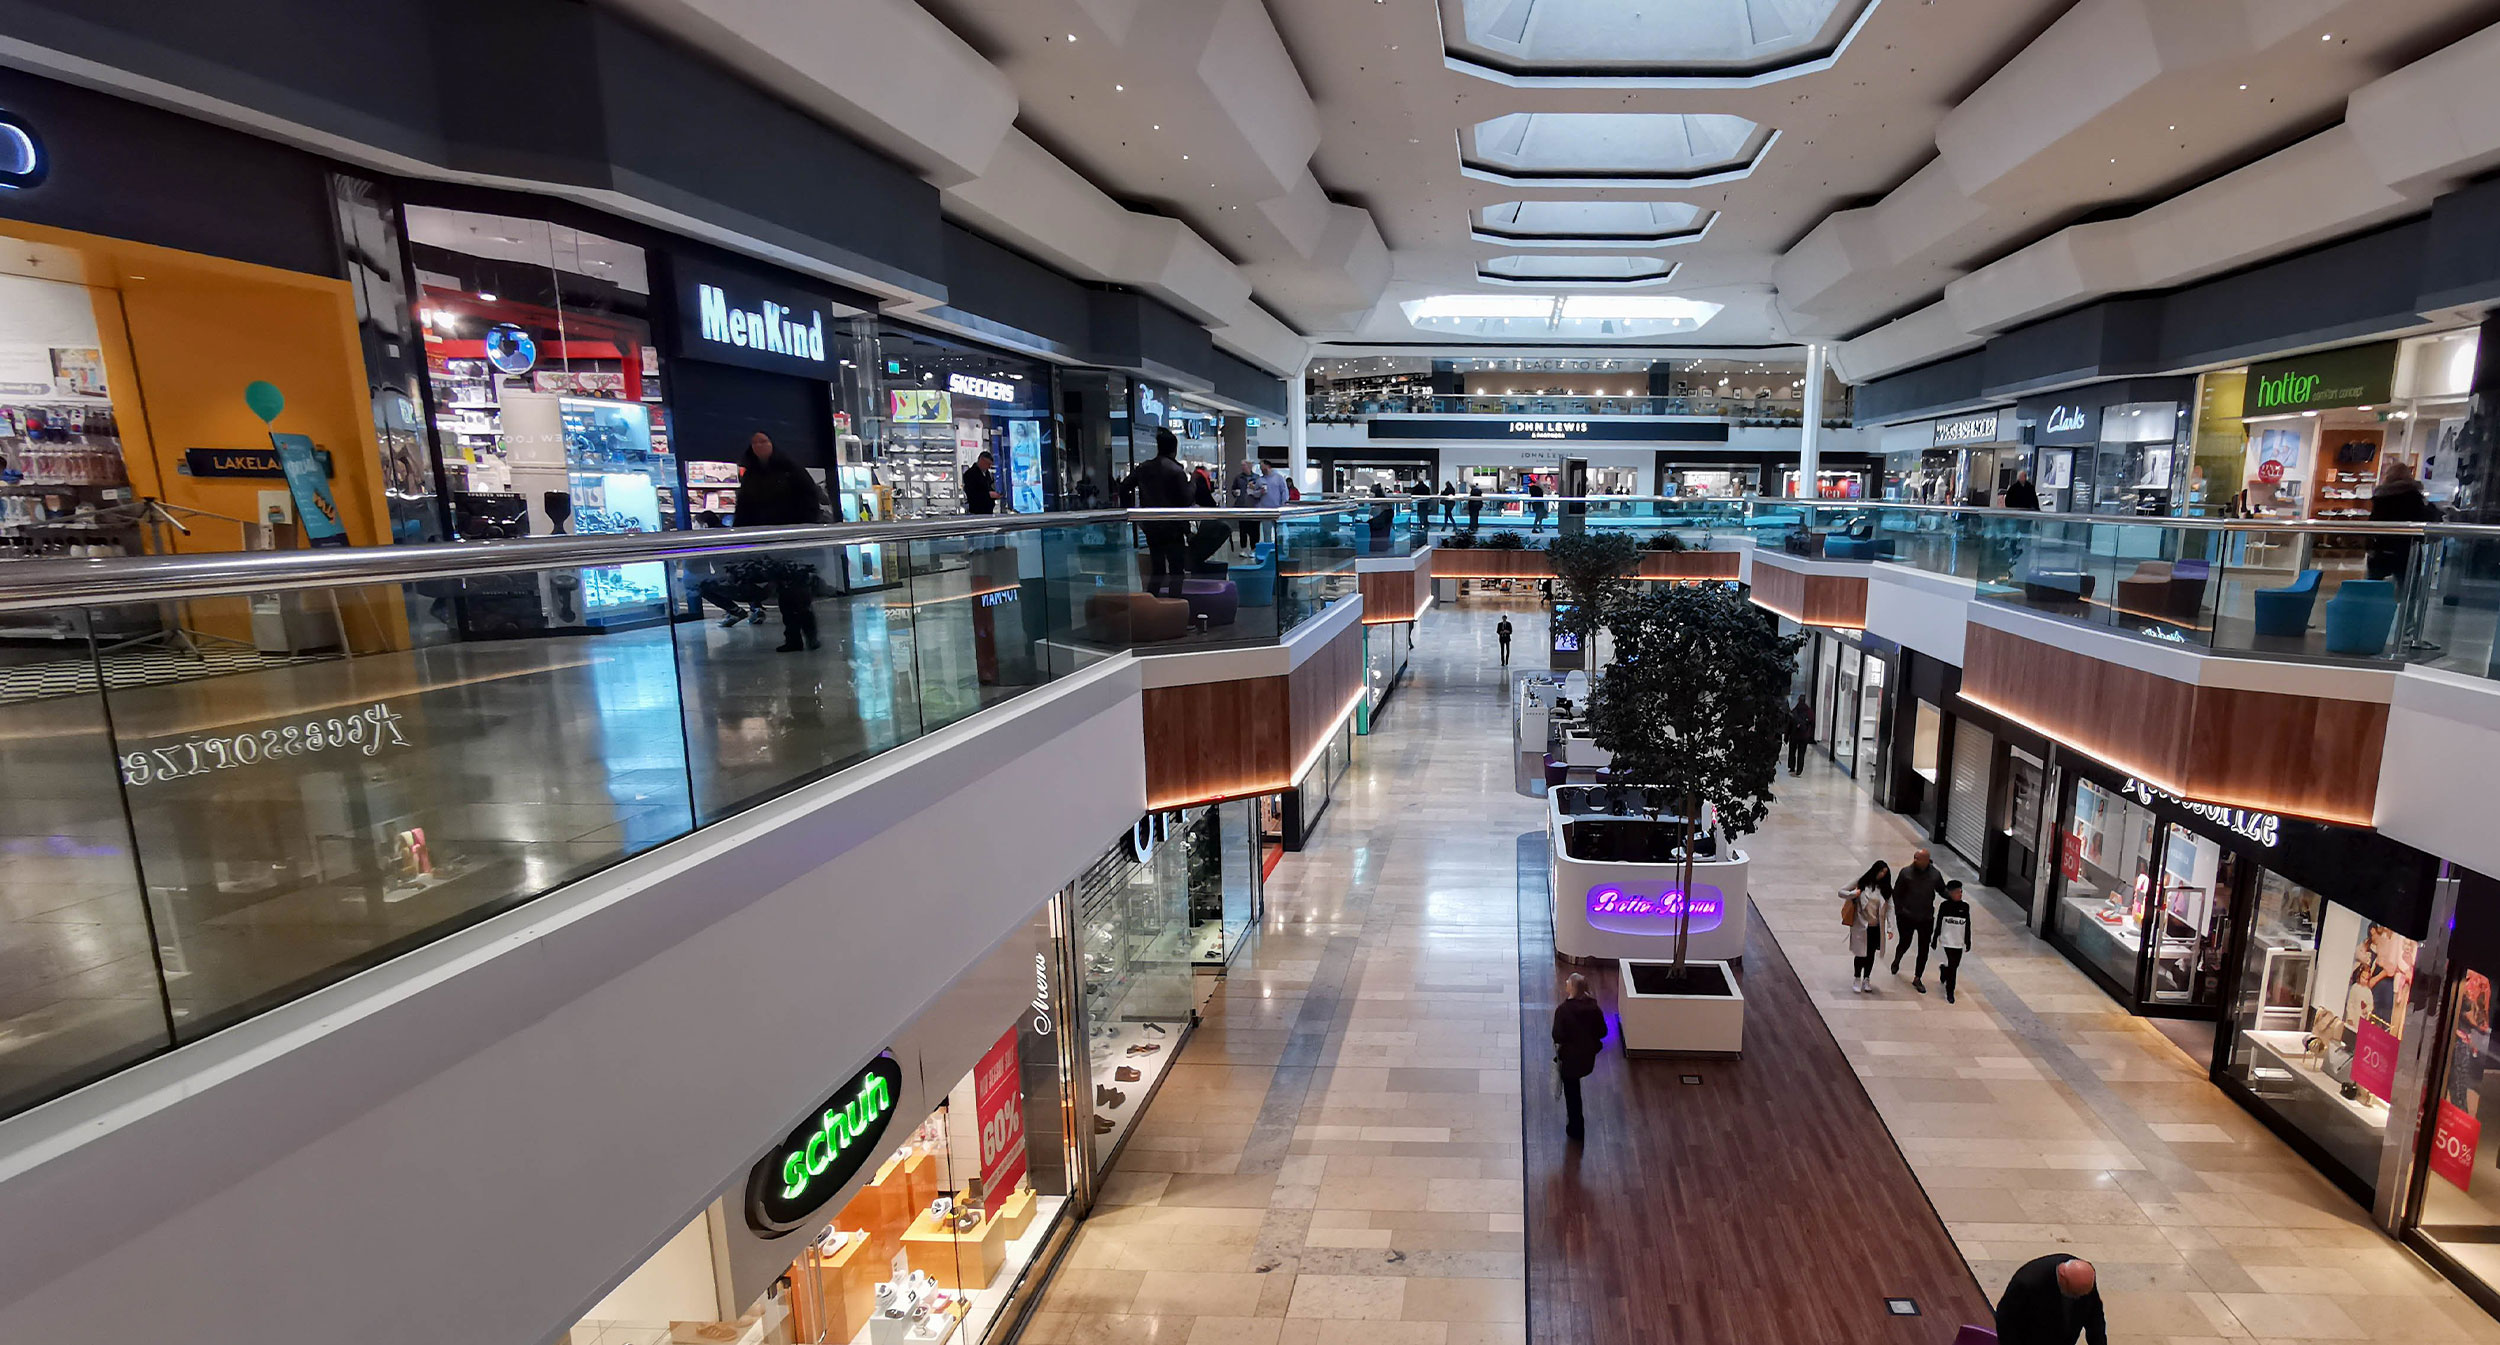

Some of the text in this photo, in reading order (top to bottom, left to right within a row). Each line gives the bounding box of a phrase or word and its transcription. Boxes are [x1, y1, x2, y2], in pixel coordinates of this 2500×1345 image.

[698, 283, 825, 361] MenKind
[1476, 360, 1623, 370] THE PLACE TO EAT
[949, 372, 1015, 403] SKECHERS
[2257, 371, 2320, 407] hotter
[1509, 422, 1588, 432] JOHN LEWIS
[2046, 405, 2085, 433] Clarks
[213, 456, 283, 470] LAKELA
[2121, 777, 2280, 847] Asorize
[1655, 891, 1718, 914] Bows
[782, 1071, 890, 1200] schuh
[983, 1090, 1020, 1167] 60%
[2435, 1127, 2472, 1162] 50%
